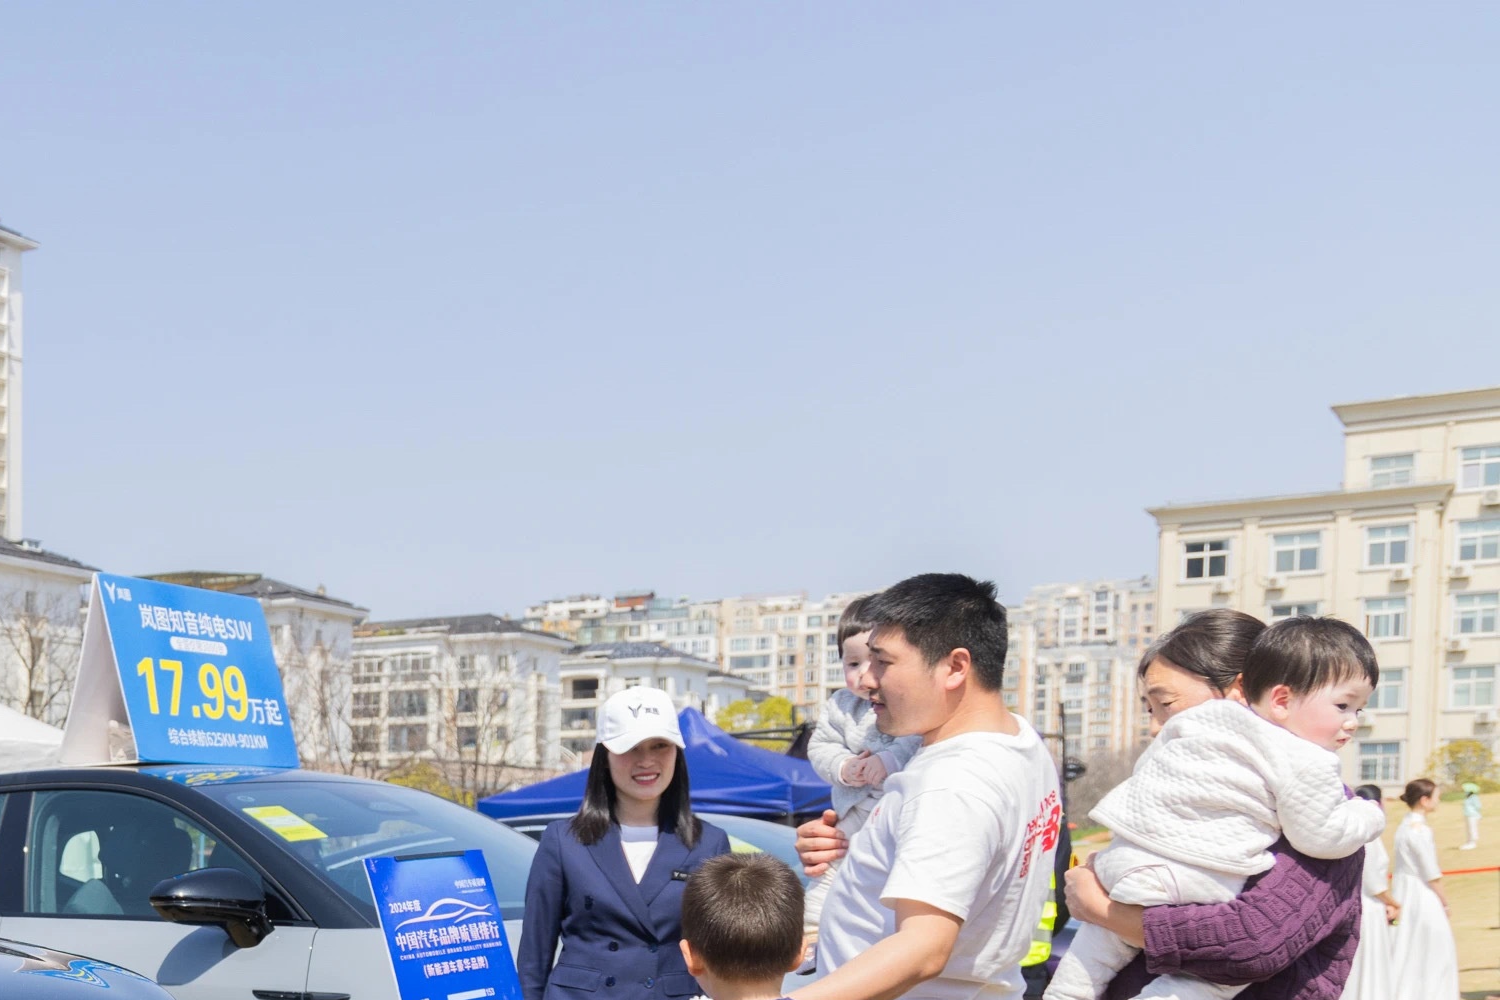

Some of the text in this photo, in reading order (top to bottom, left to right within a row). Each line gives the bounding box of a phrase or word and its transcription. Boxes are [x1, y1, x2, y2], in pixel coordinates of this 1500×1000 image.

[139, 603, 252, 641] 岚图知音纯电SUV
[388, 900, 421, 913] 2024年度
[395, 920, 499, 951] 中国汽车品牌质量排行
